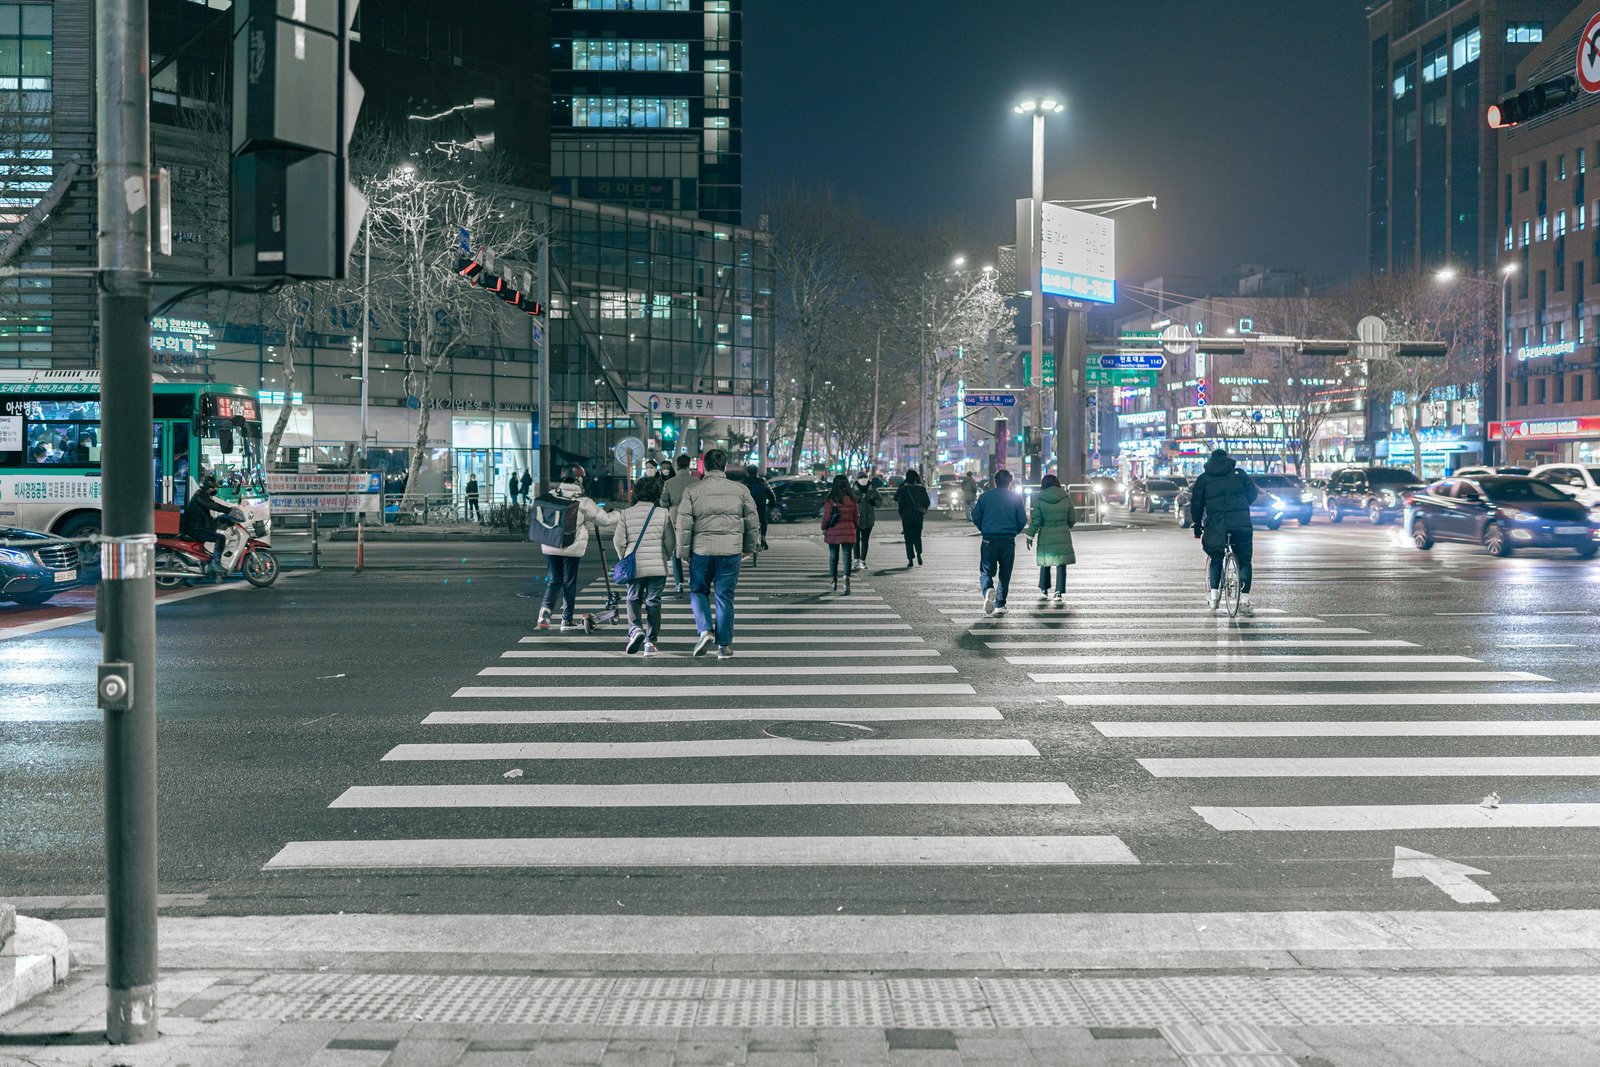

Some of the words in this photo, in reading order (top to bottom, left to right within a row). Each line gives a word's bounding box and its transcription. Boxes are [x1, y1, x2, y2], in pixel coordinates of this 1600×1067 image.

[151, 337, 192, 352] 무회계
[1120, 355, 1145, 363] 천호대로
[6, 401, 40, 416] 아산병원
[446, 398, 482, 411] 기업은행
[664, 397, 713, 410] 강동세무서
[15, 482, 47, 498] 미사경정공원
[295, 497, 318, 507] 자동차세
[320, 496, 337, 506] 납부의
